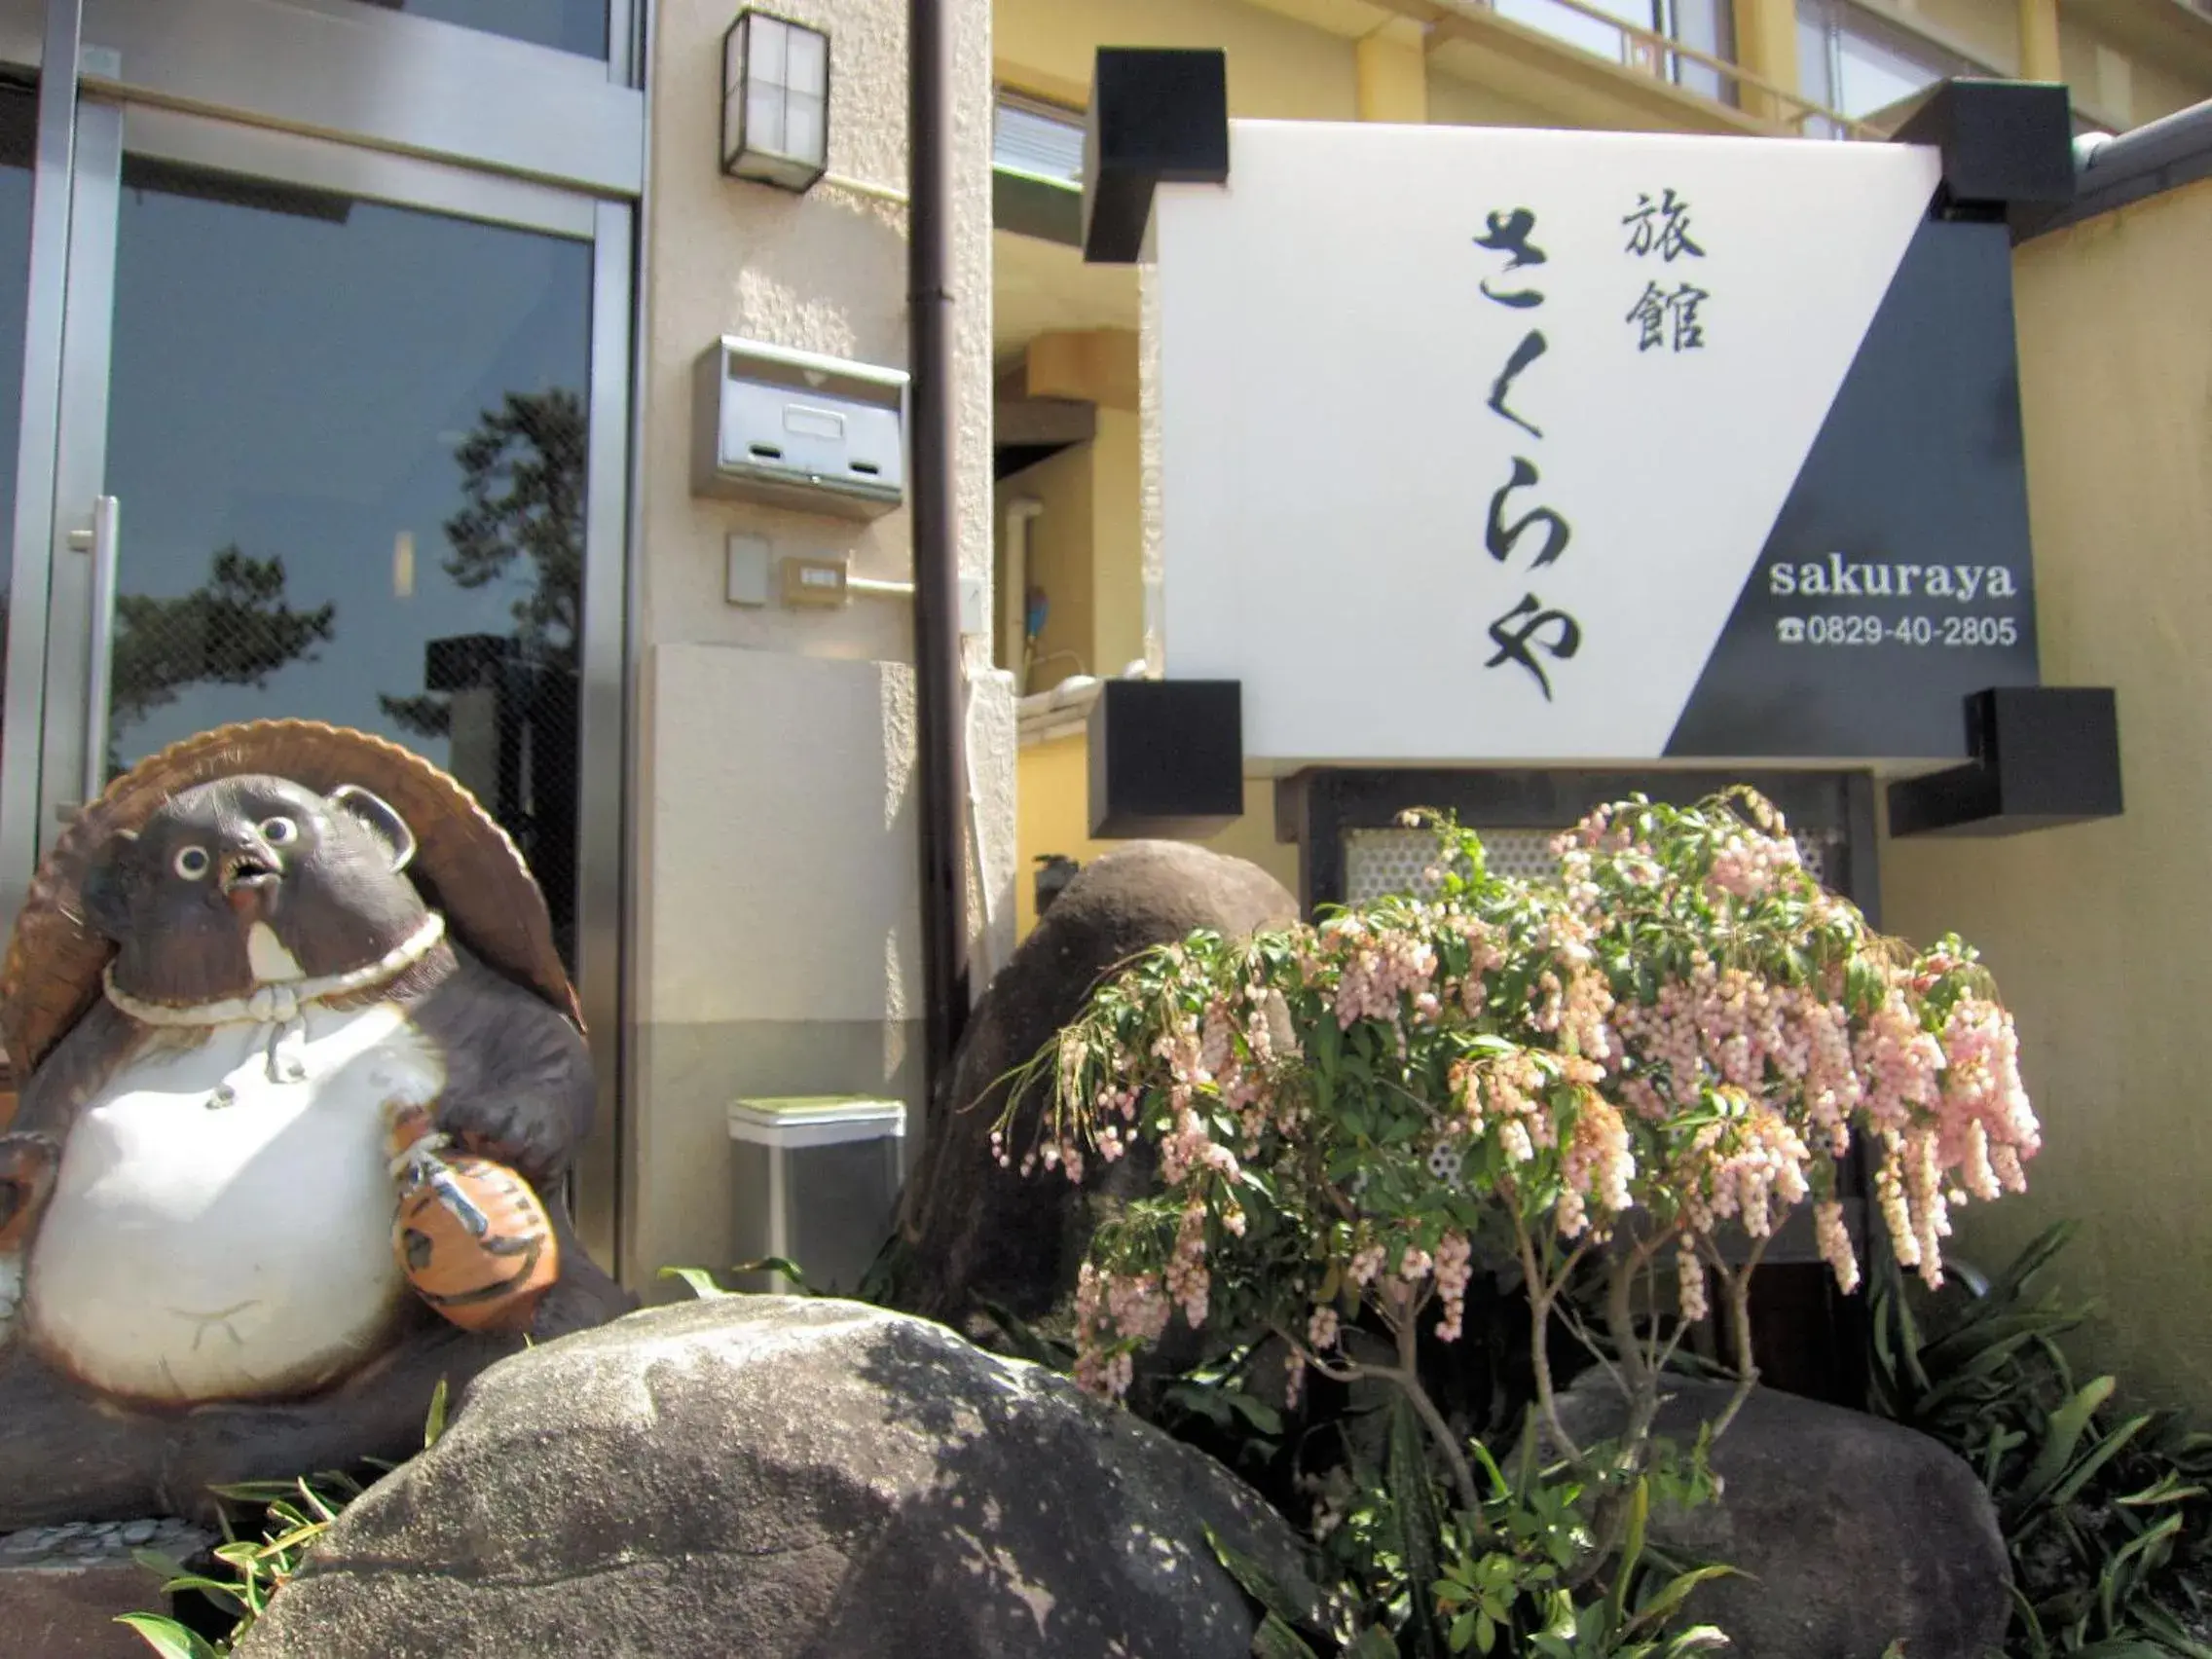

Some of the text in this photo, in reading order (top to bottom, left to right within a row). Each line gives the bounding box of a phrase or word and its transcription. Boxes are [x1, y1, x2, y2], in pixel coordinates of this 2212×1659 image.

[1621, 188, 1710, 353] 旅館
[1473, 207, 1582, 702] さくらや
[1769, 553, 2017, 601] sakuraya
[1808, 615, 2017, 646] 0829-40-2805
